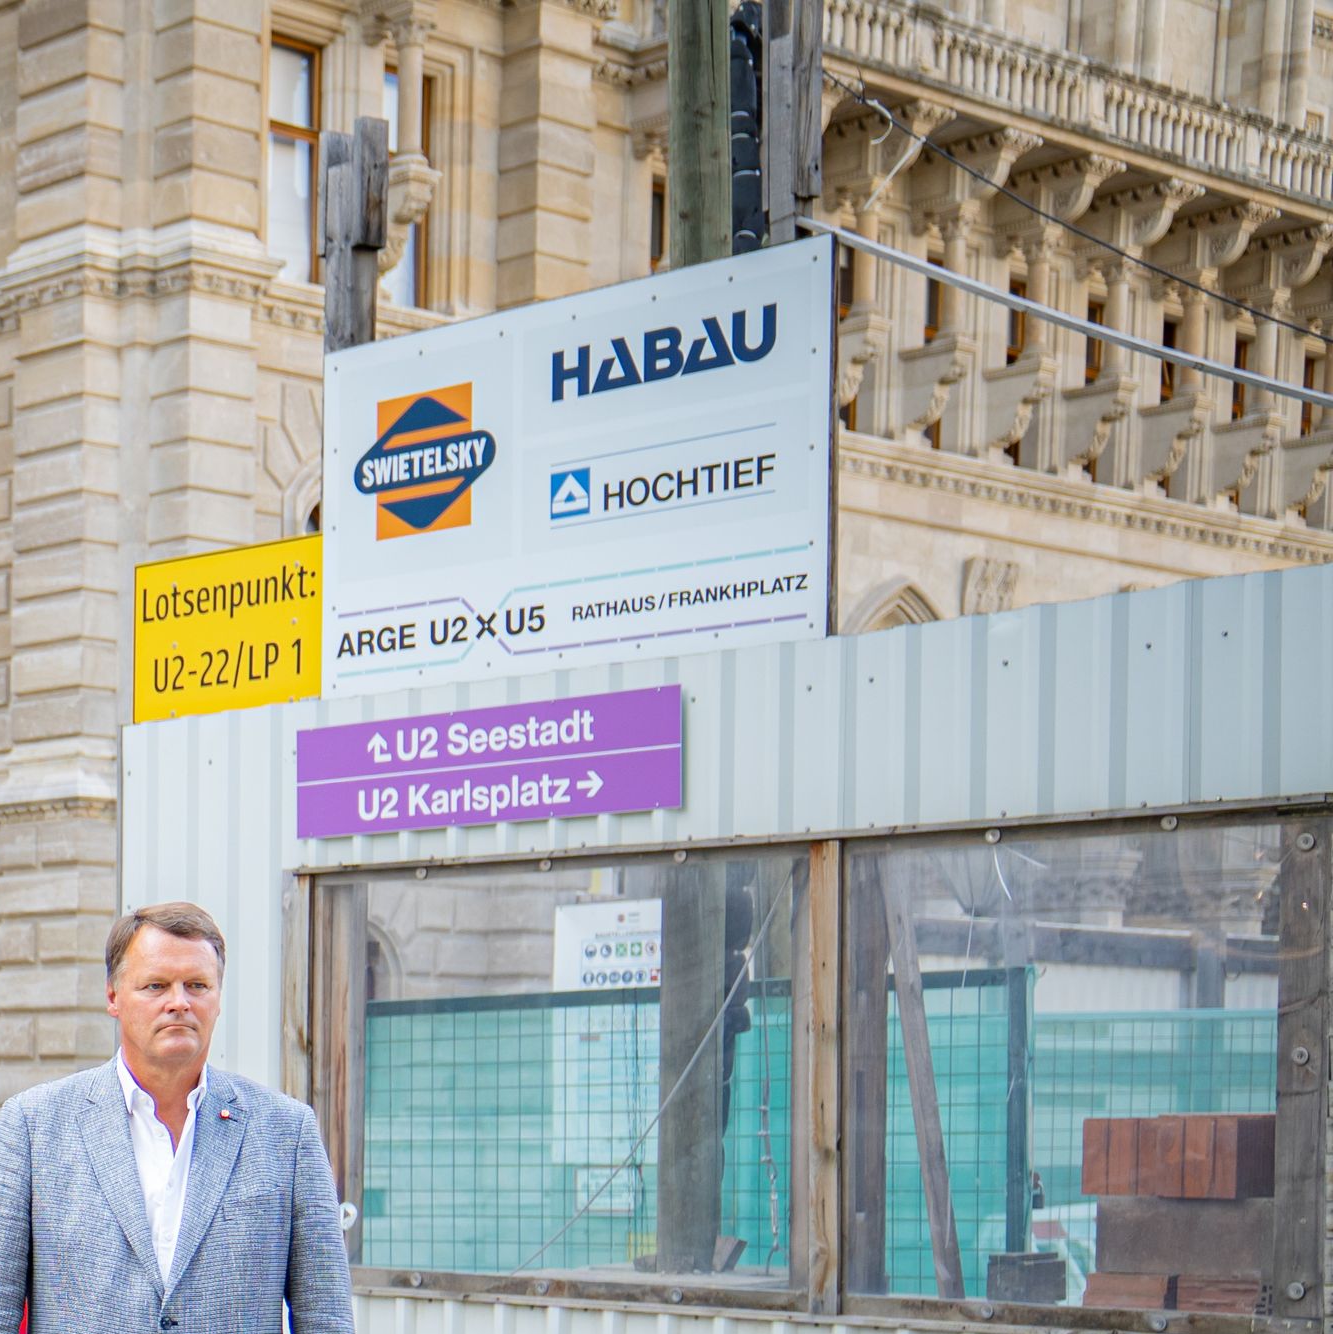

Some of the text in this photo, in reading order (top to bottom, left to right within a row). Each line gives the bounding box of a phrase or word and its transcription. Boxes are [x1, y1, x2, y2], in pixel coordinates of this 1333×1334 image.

[551, 303, 777, 402] HABAU
[362, 437, 487, 488] SWIETELSKY
[603, 453, 777, 512] HOCHTIEF
[142, 565, 316, 623] Lotsenpunkt:
[153, 638, 302, 693] U2-22/LP 1
[336, 623, 416, 659] ARGE
[396, 709, 595, 762] U2 Seestadt
[358, 773, 571, 821] U2 Karlsplatz
